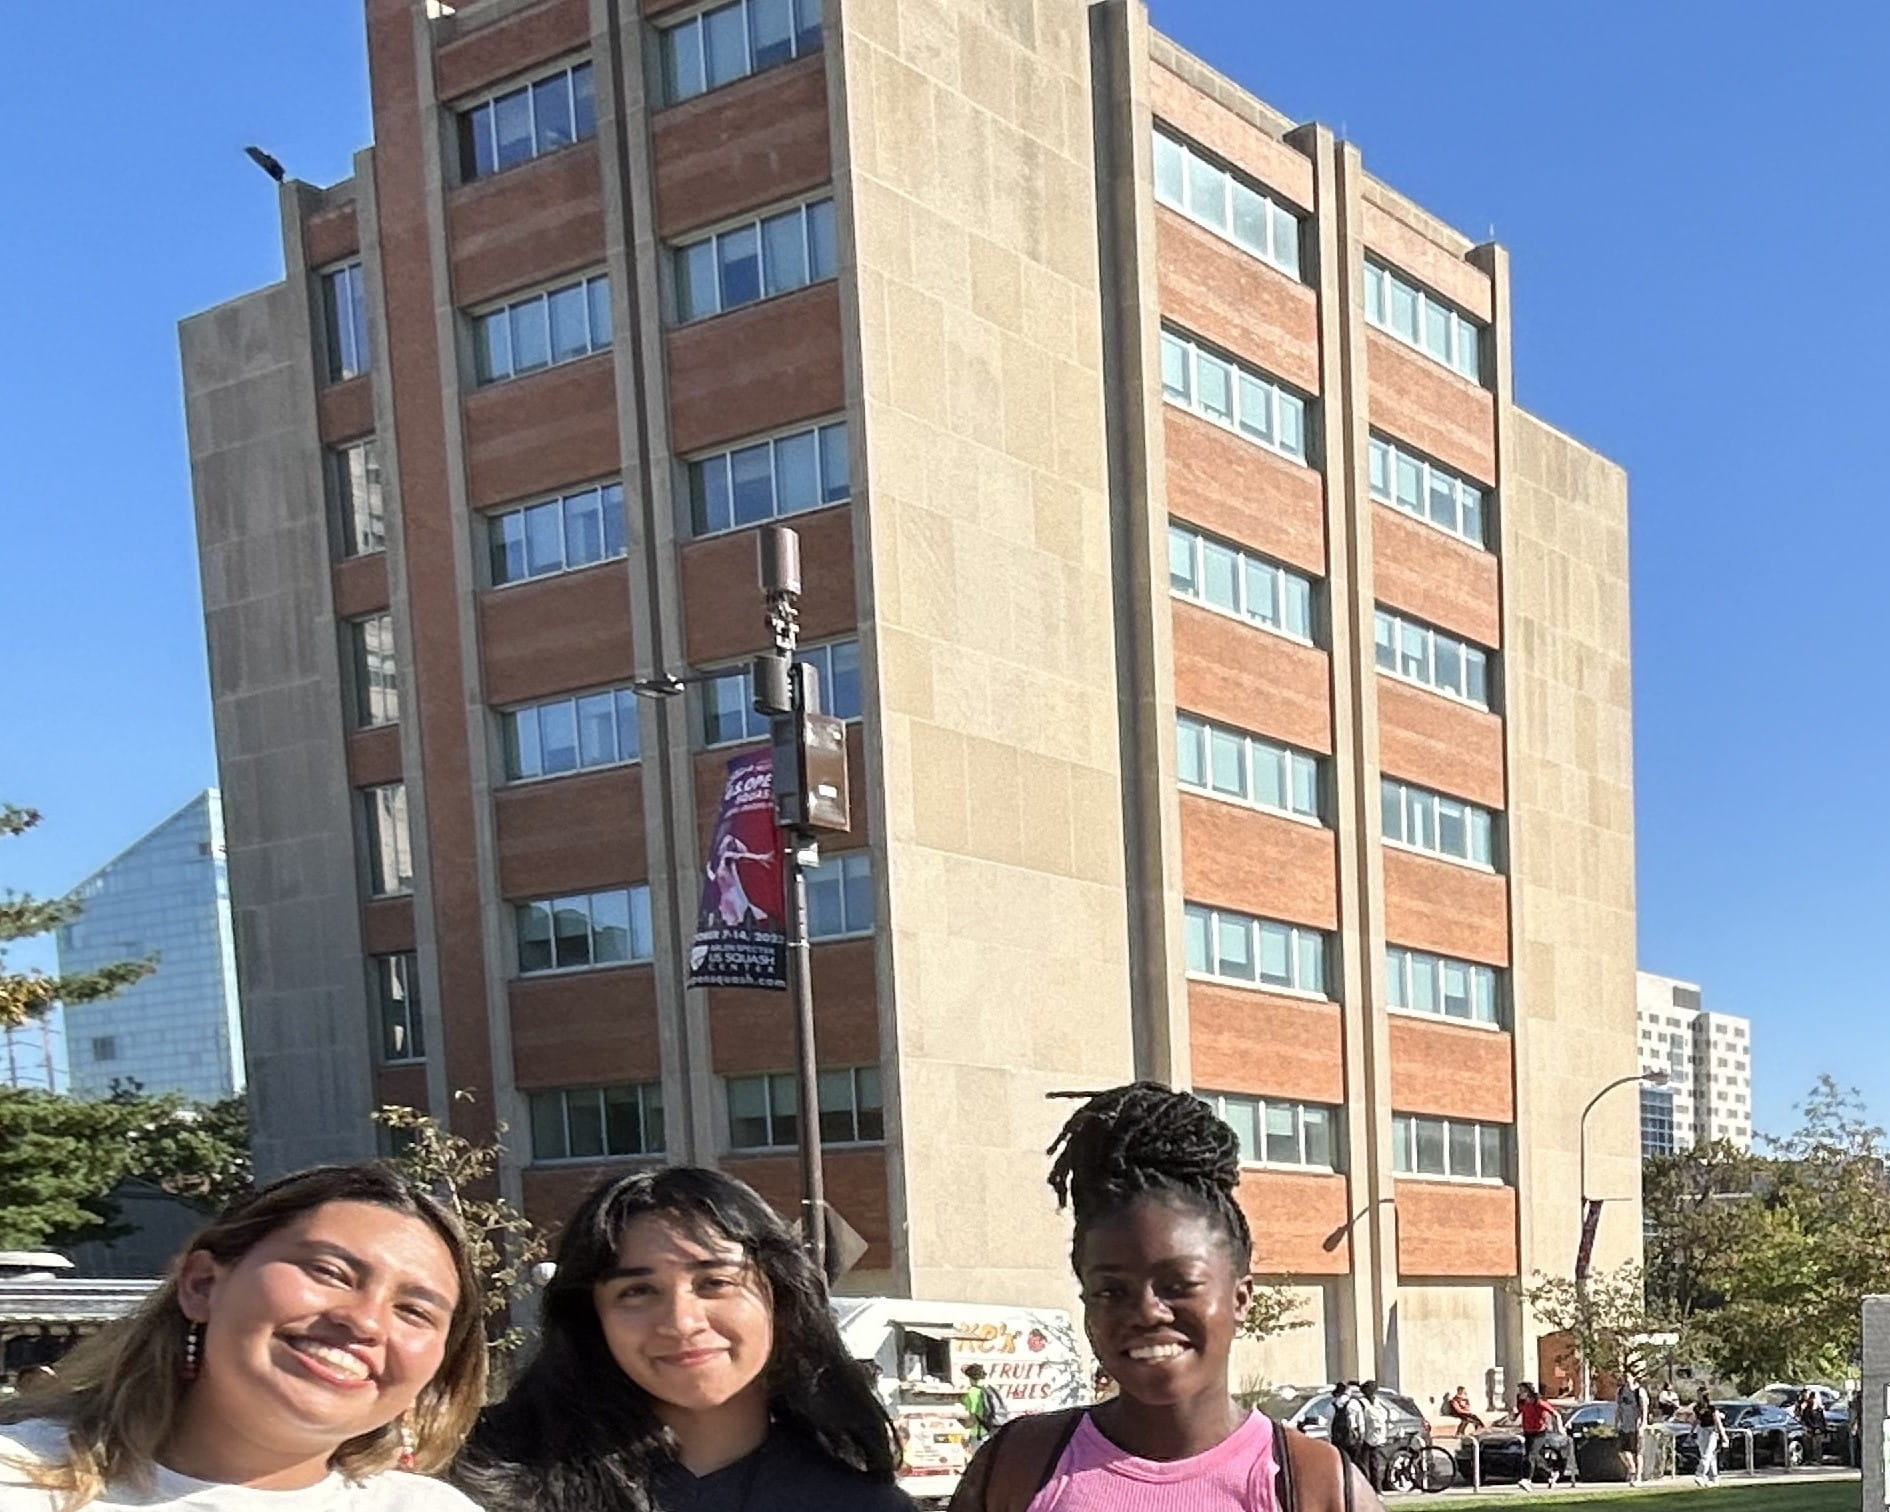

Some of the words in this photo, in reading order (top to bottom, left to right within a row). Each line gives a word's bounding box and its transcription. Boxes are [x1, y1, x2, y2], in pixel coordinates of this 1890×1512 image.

[744, 773, 773, 791] OPE
[724, 952, 775, 966] SQUASH
[989, 1362, 1047, 1380] FRUIT
